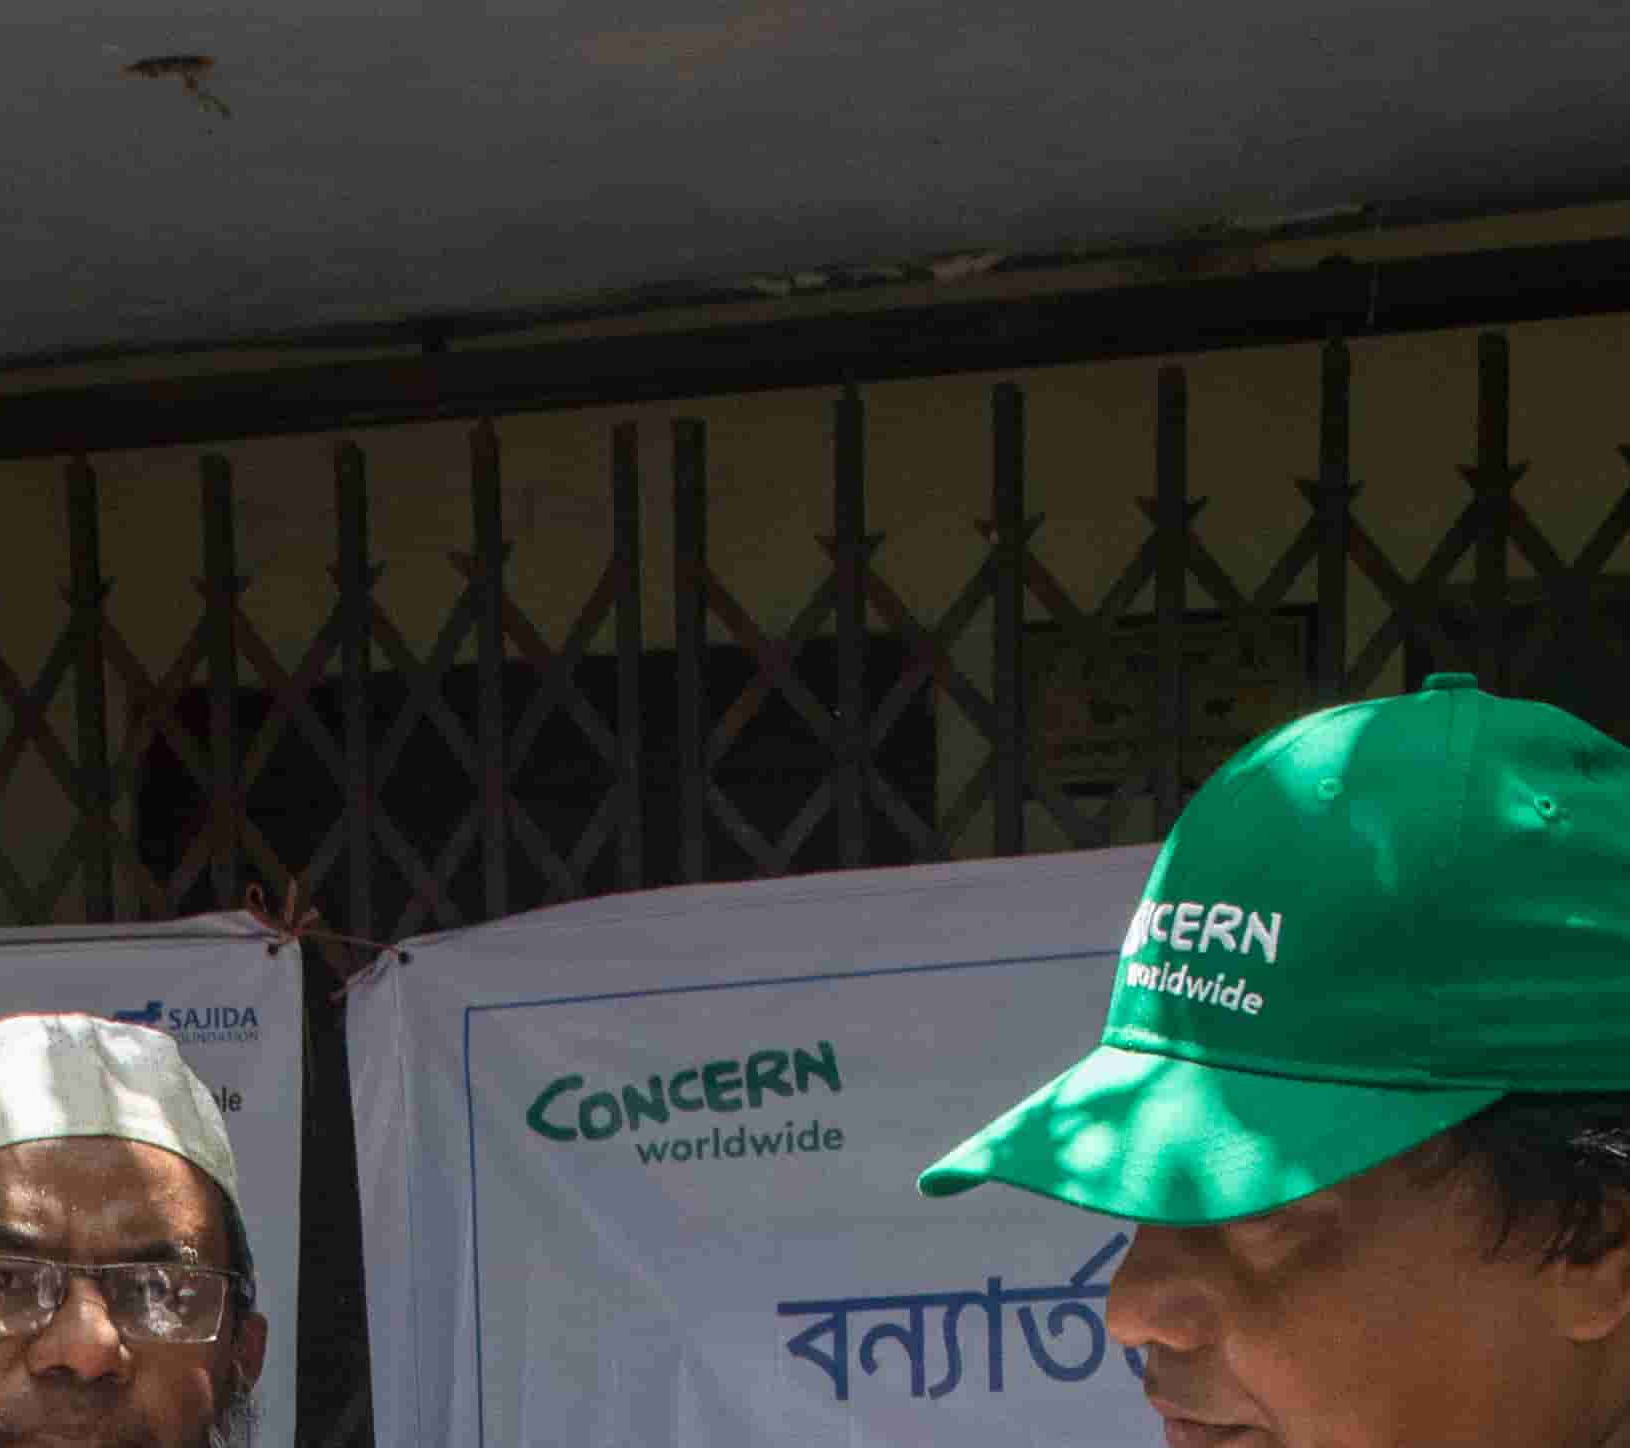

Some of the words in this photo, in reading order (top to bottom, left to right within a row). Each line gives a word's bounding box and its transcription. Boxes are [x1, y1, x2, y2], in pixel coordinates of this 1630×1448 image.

[168, 1007, 258, 1031] SAJIDA
[526, 1039, 842, 1142] CONCERN
[635, 1119, 845, 1166] worldwide
[776, 1231, 1146, 1401] বন্যার্ত
